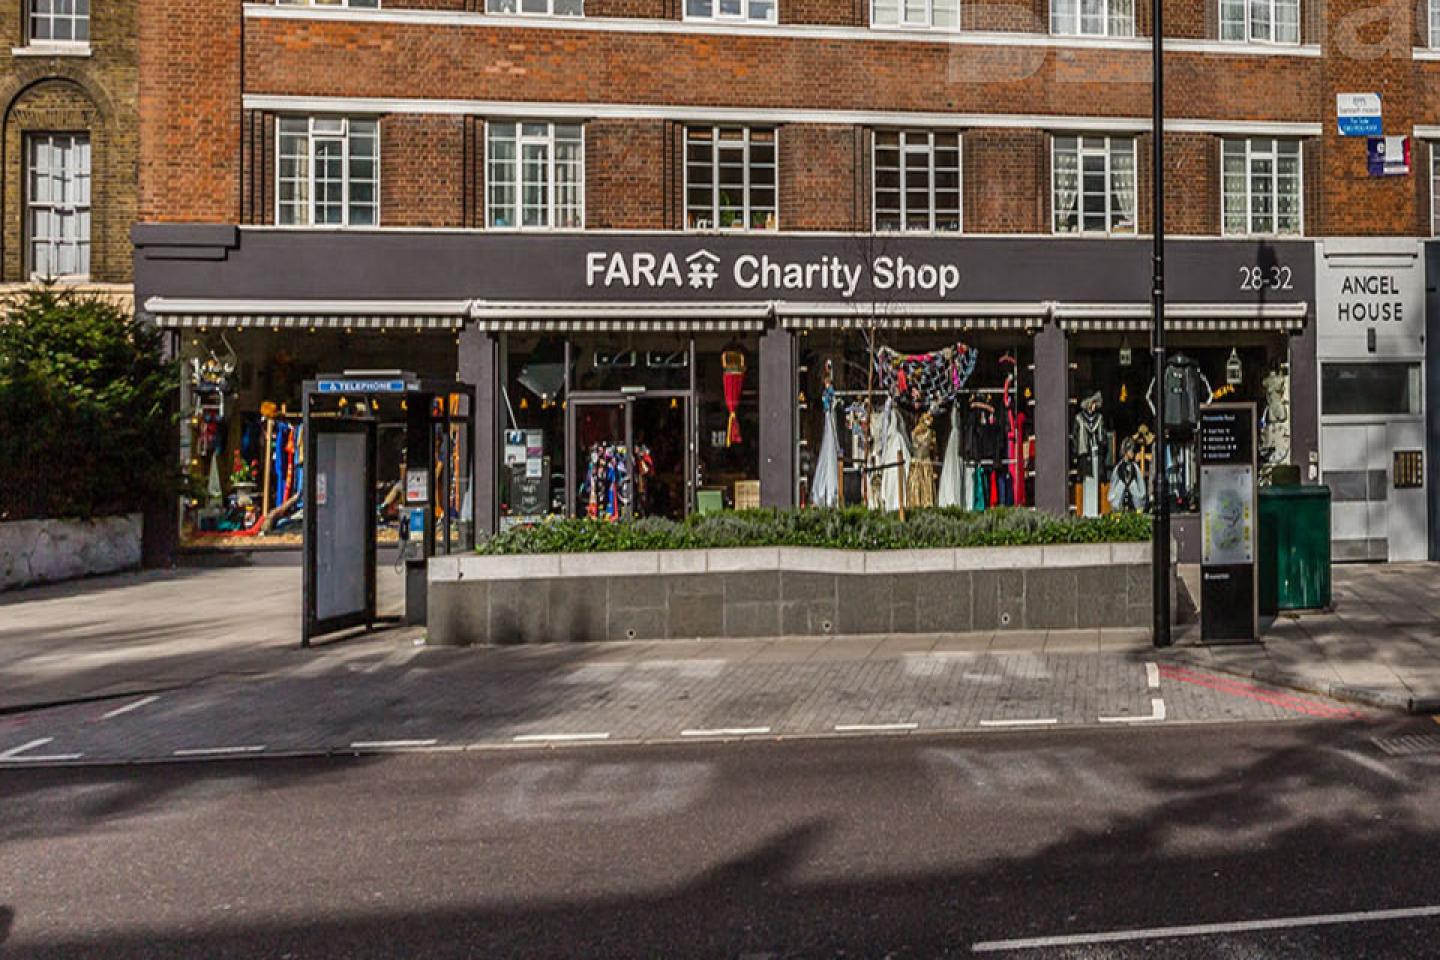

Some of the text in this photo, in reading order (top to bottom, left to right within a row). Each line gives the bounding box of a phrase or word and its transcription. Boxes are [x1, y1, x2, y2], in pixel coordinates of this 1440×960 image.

[586, 251, 960, 297] FARA Charity Shop
[1239, 266, 1294, 291] 28-32
[1341, 275, 1400, 295] ANGEL
[1338, 302, 1404, 322] HOUSE
[340, 382, 391, 391] TELEPHONE
